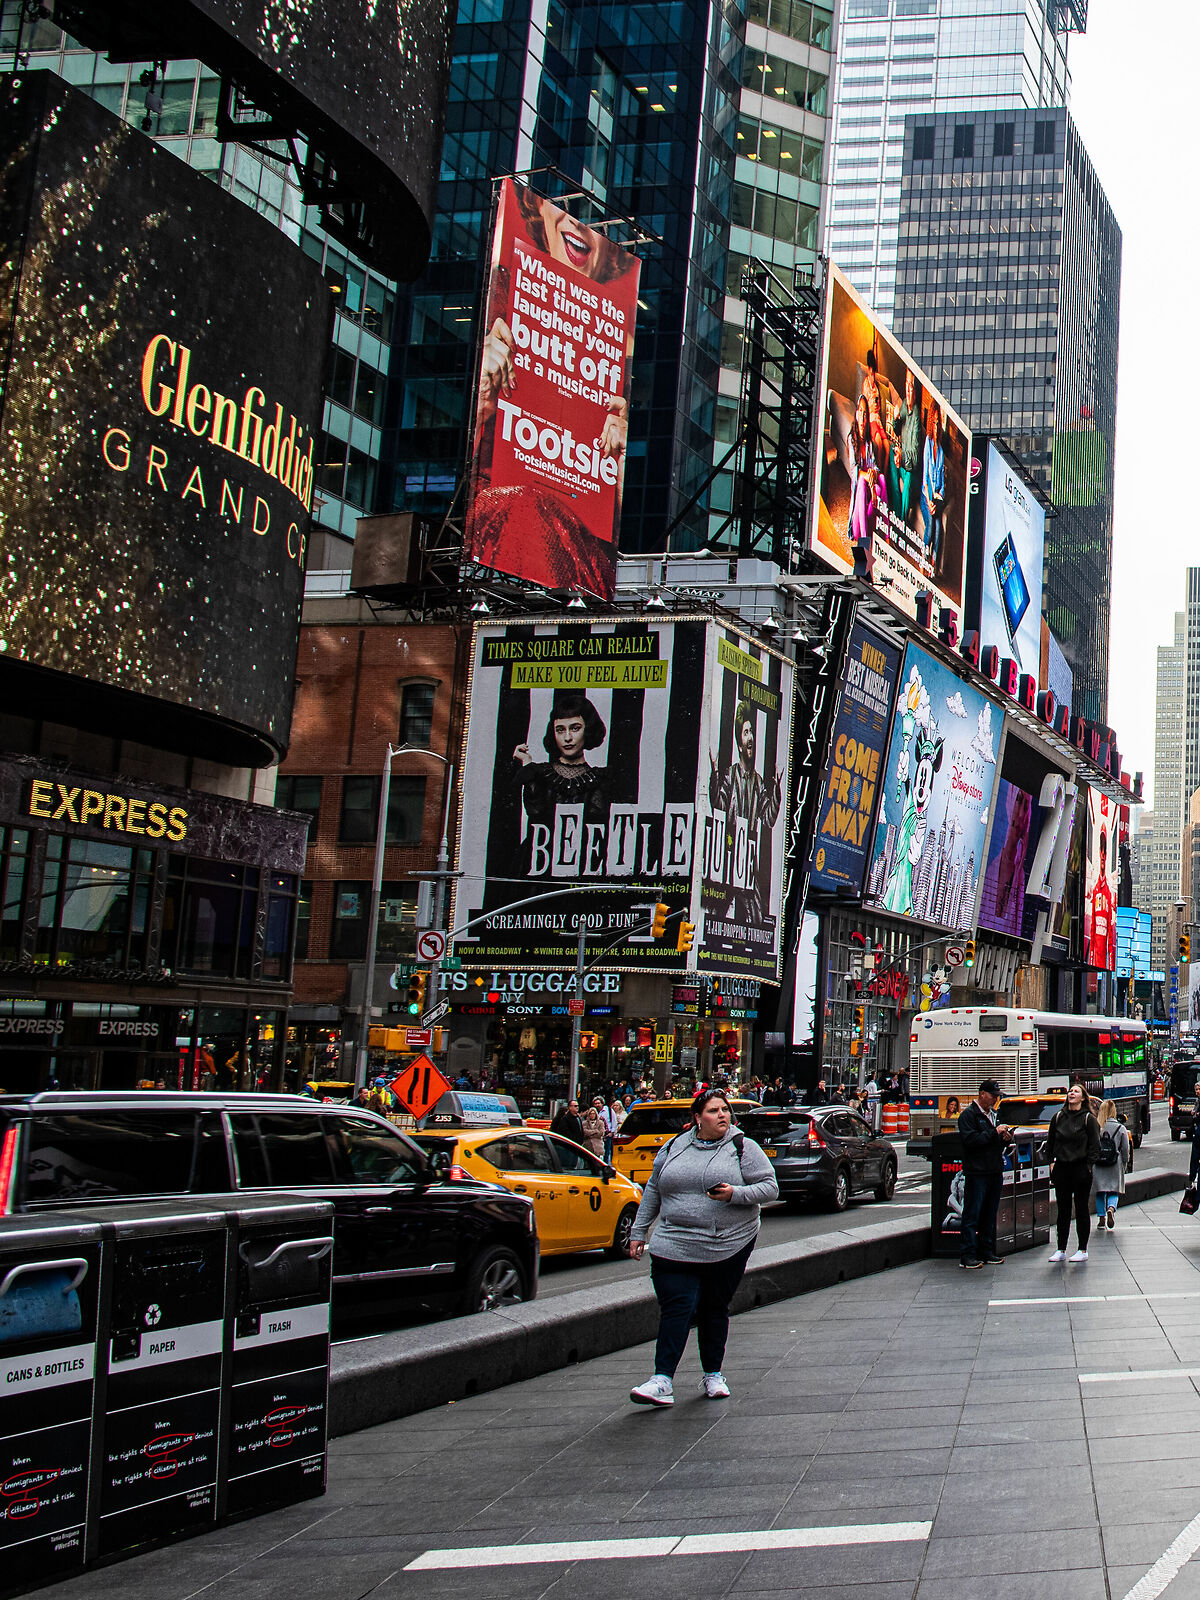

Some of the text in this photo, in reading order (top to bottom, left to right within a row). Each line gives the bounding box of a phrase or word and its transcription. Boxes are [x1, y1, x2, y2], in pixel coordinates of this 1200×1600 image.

[515, 268, 624, 344] last time you
[570, 282, 598, 309] was
[601, 297, 625, 324] the
[513, 290, 622, 362] laughed your
[511, 312, 622, 394] butt off
[514, 352, 544, 377] at a
[141, 334, 314, 513] Glenfiddich
[522, 410, 531, 418] THE
[497, 398, 618, 486] Tootsie
[102, 428, 271, 536] GRAND
[513, 447, 601, 493] TootsieMusical.com
[1004, 473, 1013, 494] LG
[876, 495, 889, 518] Talk
[889, 510, 906, 533] about
[875, 516, 906, 551] plan for an
[874, 540, 916, 585] Then go back to
[675, 586, 722, 599] LAMAR
[487, 635, 655, 660] TIMES SQUARE CAN REALLY
[722, 644, 742, 670] RAISING
[516, 663, 664, 684] MAKE YOU FEEL ALIVE!
[847, 658, 891, 706] BEST MUSICAL
[915, 590, 1123, 780] 1540 BROADWAY
[834, 733, 880, 783] COME
[952, 748, 985, 779] WELCOME
[827, 765, 876, 815] FROM
[951, 765, 970, 801] Disney
[969, 784, 983, 801] store
[29, 779, 188, 841] EXPRESS
[820, 802, 870, 847] AWAY
[527, 803, 695, 877] BEETLE
[571, 913, 603, 929] GOOD
[712, 921, 747, 940] JAW-DROPPING
[459, 947, 522, 955] NOW ON BROADWAY
[539, 948, 645, 956] WINTER GAREN 50TH &
[410, 964, 417, 973] 46
[490, 972, 620, 993] LUGGAGE
[719, 977, 761, 998] LUGGAGE
[460, 1005, 544, 1014] Canon SONY
[481, 992, 524, 1003] I NY
[0, 1018, 65, 1034] EXPRESS
[729, 1010, 746, 1018] SONY
[99, 1020, 159, 1036] EXPRESS
[656, 1035, 665, 1059] ATM
[957, 1038, 979, 1048] 4329
[268, 1320, 292, 1334] TRASH
[149, 1340, 176, 1355] PAPER
[6, 1358, 85, 1383] CANS & BOTTLES
[120, 1429, 214, 1461] rights immigrants are denied
[12, 1456, 31, 1466] When
[124, 1463, 176, 1484] rights citizens
[4, 1464, 83, 1490] immigrants are denied
[10, 1491, 76, 1514] citizens are at risk
